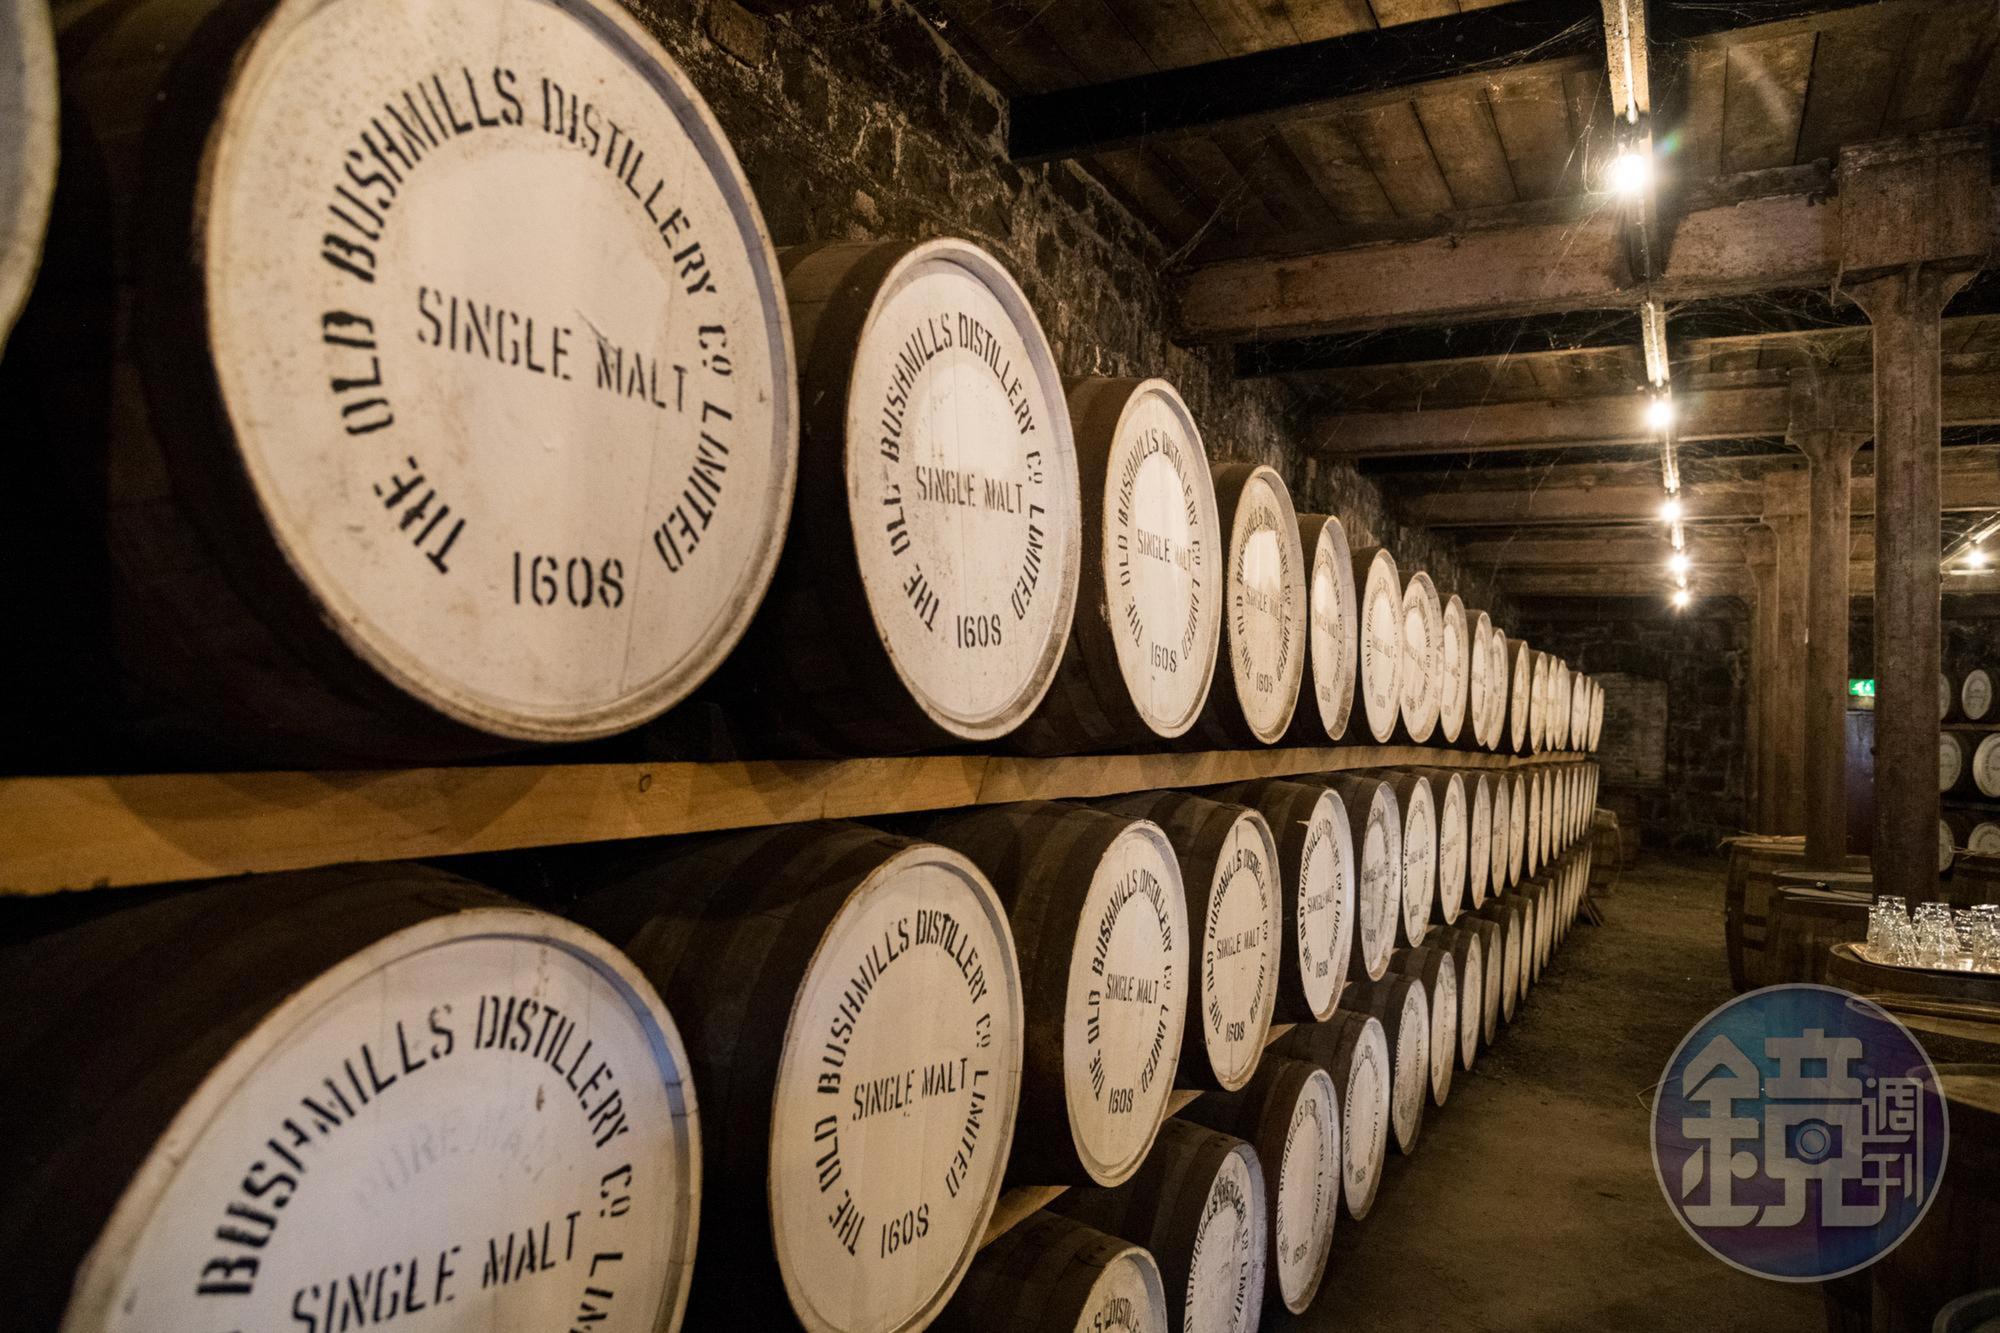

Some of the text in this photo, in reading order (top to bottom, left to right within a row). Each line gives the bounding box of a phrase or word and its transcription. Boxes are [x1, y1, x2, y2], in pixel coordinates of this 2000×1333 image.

[321, 66, 523, 283] BUSHMILLS
[541, 77, 717, 296] DISTILLERY
[322, 309, 394, 435] OLD
[417, 286, 688, 412] SINGLE MALT
[880, 312, 953, 463] BUSHMILLS
[958, 312, 1035, 435] DISTILLERY
[373, 456, 467, 574] THE
[654, 400, 733, 573] LIMITED
[915, 465, 1023, 514] SINGLE MALT
[1117, 427, 1159, 528] BUSHMILLS
[512, 550, 625, 608] 1608
[1011, 503, 1045, 620] LIMITED
[1118, 534, 1130, 586] OLD
[1137, 529, 1171, 563] SINGLE
[902, 563, 940, 632] THE
[956, 613, 1002, 649] 1608
[1125, 596, 1142, 648] THE
[1181, 578, 1200, 660] LIMITED
[1091, 868, 1139, 977] BUSHMILLS
[1138, 868, 1173, 953] DISTILLERY
[1216, 926, 1261, 961] SINGLE MALT
[915, 908, 988, 1004] DISTILLERY
[1105, 972, 1160, 1004] SINGLE MALT
[817, 917, 911, 1094] BUSHMILLS
[1087, 989, 1101, 1045] OLD
[852, 1057, 969, 1121] SINGLE MALT
[1089, 1049, 1106, 1102] THE
[1140, 1003, 1169, 1094] LIMITED
[945, 1069, 990, 1199] LIMITED
[1108, 1088, 1134, 1115] 1608
[196, 1002, 455, 1296] BUSHMILLS
[473, 995, 630, 1149] DISTILLERY
[814, 1114, 842, 1193] OLD
[828, 1189, 866, 1258] THE
[880, 1203, 931, 1260] 1608
[292, 1210, 582, 1333] SINGLE MALT
